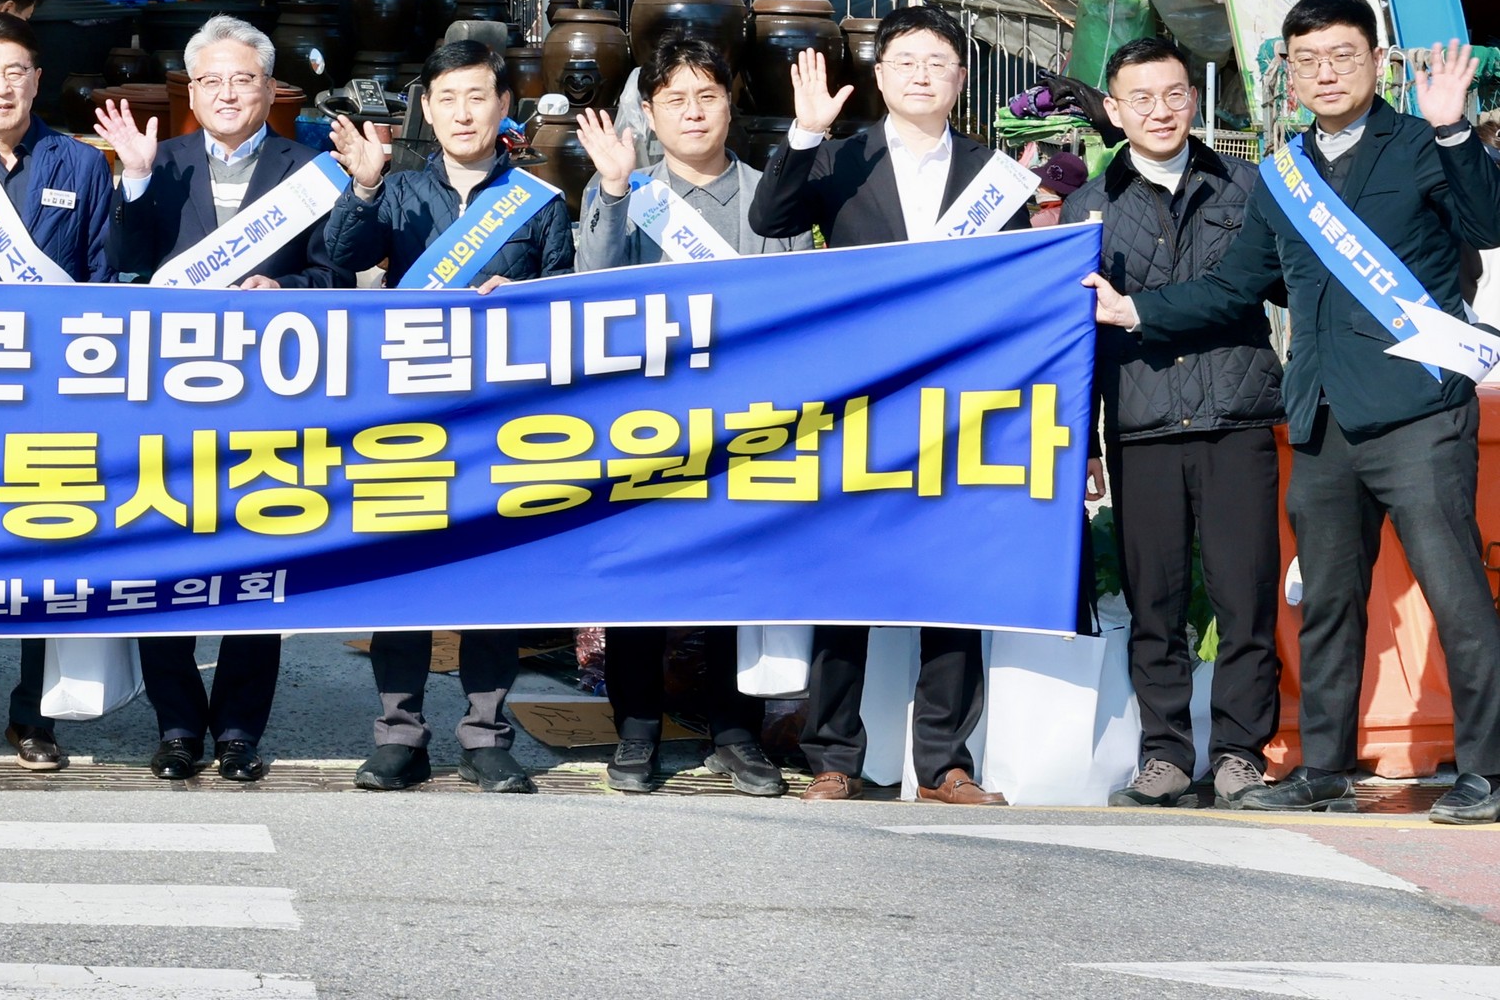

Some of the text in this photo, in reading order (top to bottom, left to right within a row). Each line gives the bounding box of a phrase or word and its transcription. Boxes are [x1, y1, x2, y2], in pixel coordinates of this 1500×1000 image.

[185, 204, 288, 286] 전통시장을
[1308, 201, 1399, 296] 함께합니다
[57, 309, 348, 402] 희망이
[380, 293, 715, 396] 됩니다!
[489, 383, 1071, 519] 응원합니다
